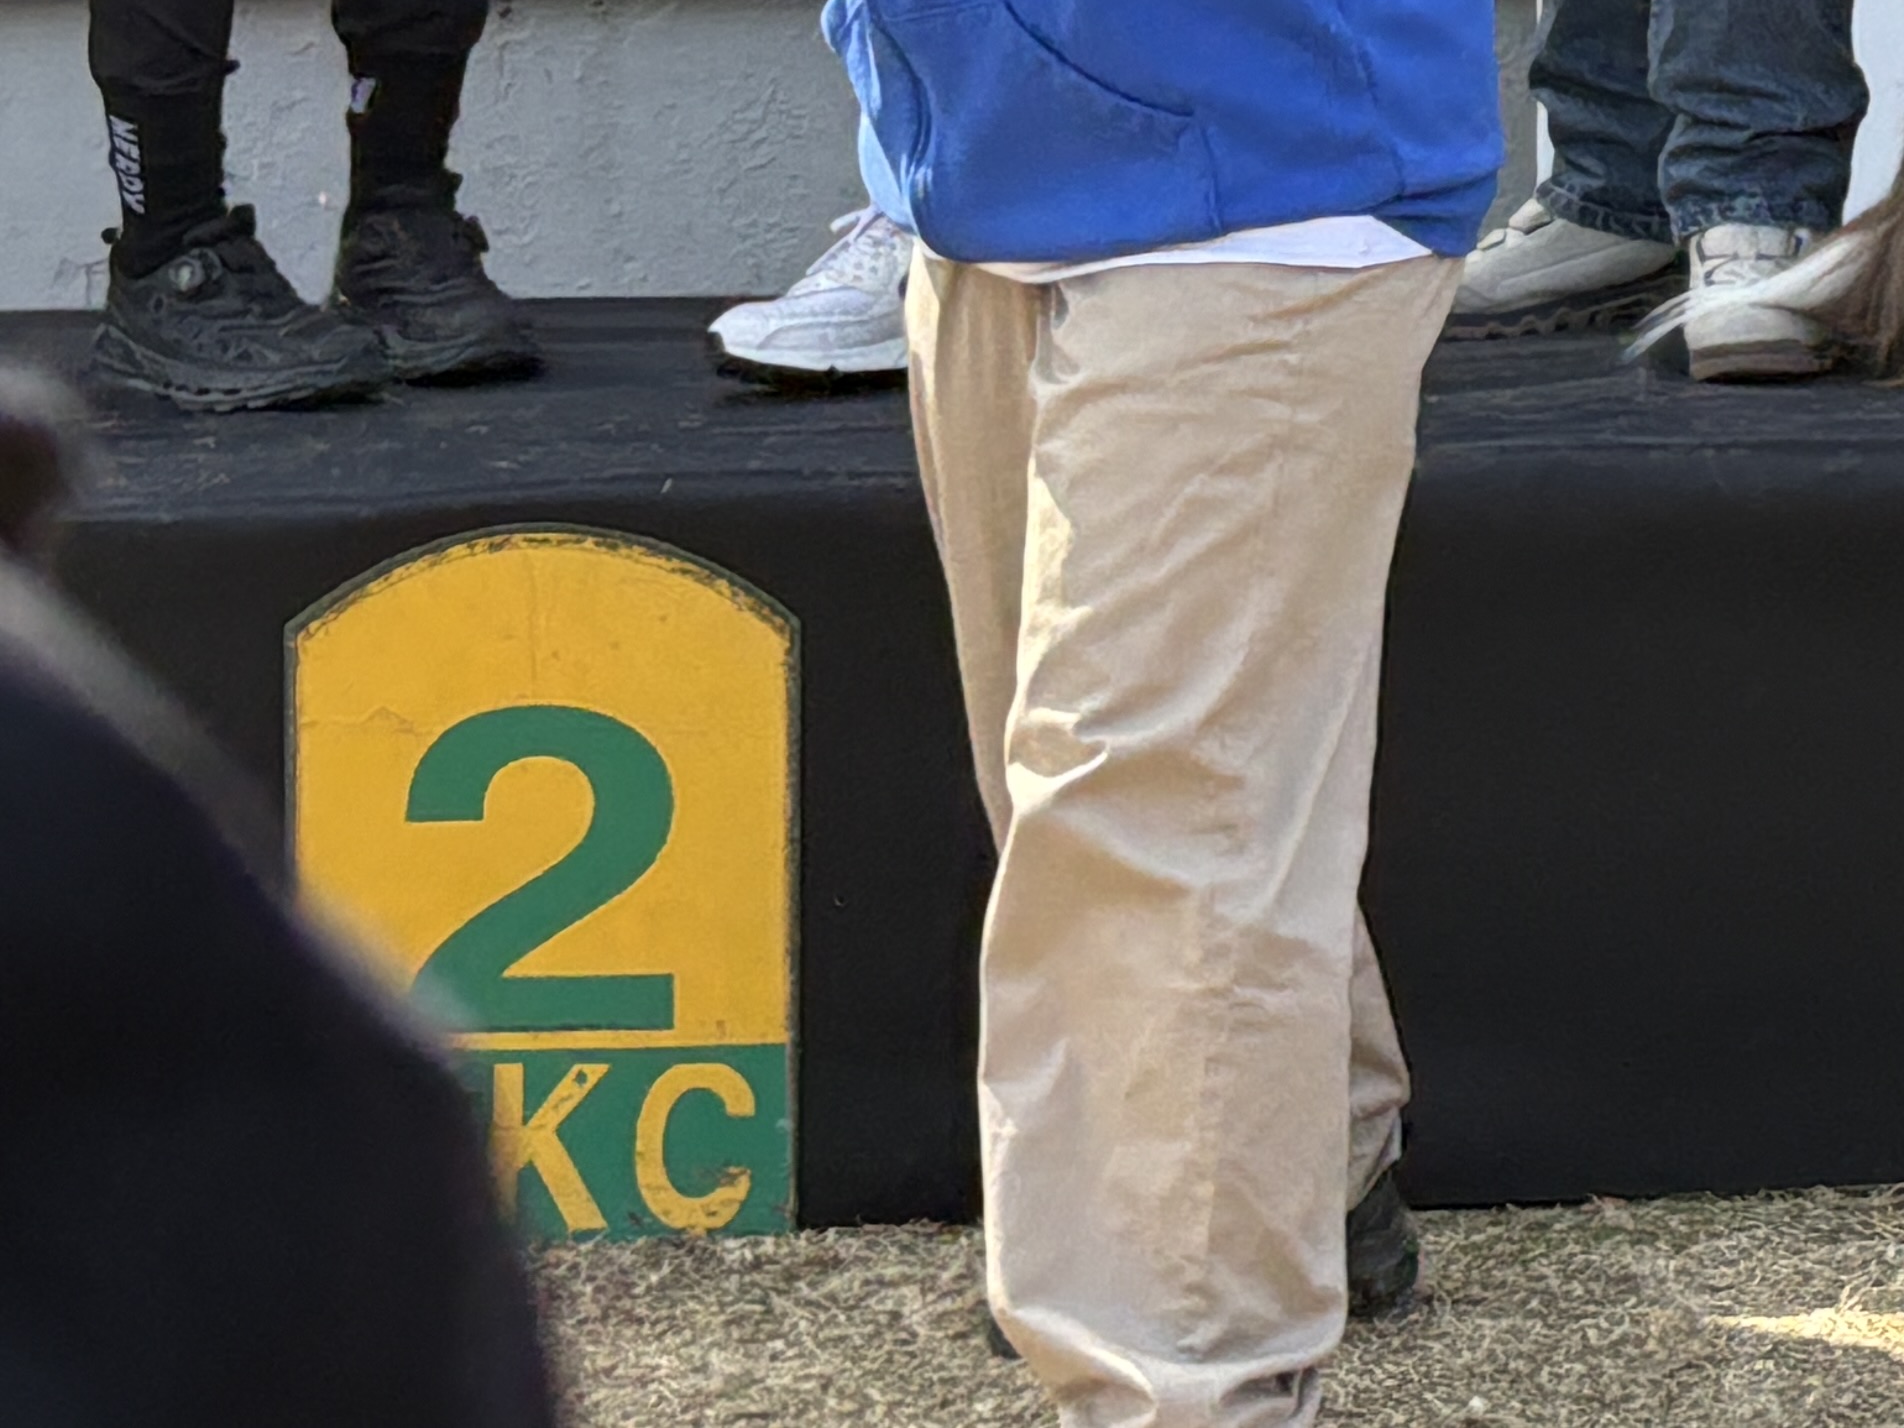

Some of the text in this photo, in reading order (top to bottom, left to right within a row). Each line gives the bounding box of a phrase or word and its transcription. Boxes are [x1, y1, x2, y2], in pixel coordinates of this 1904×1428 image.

[108, 114, 147, 216] NERDY
[405, 704, 676, 1034] 2
[488, 1061, 756, 1233] KC
